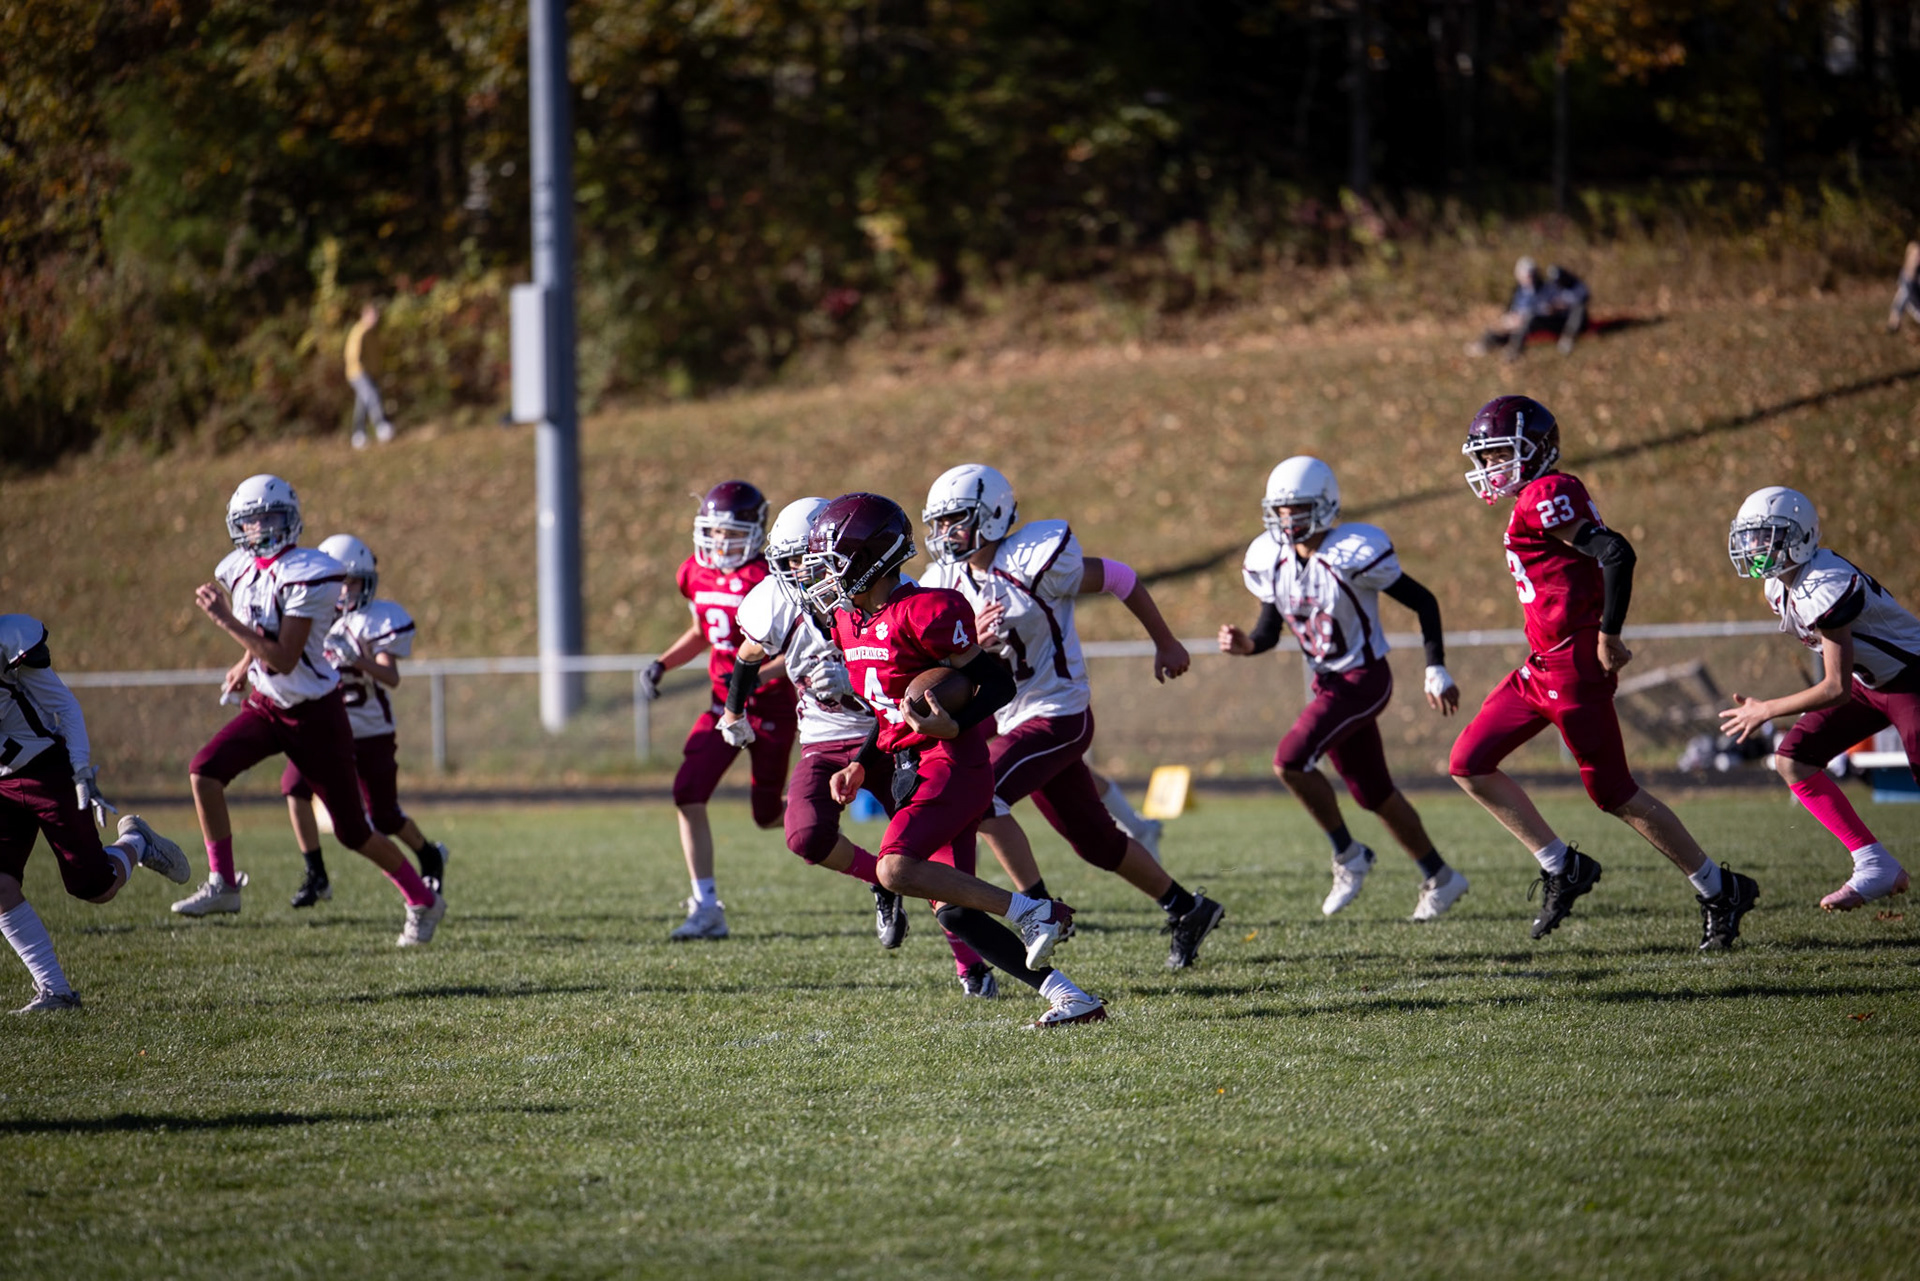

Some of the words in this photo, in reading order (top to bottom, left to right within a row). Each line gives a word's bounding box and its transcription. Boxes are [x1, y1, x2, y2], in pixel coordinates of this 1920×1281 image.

[1535, 494, 1575, 528] 23
[705, 608, 734, 651] 2
[952, 619, 970, 649] 4
[864, 667, 904, 724] 4
